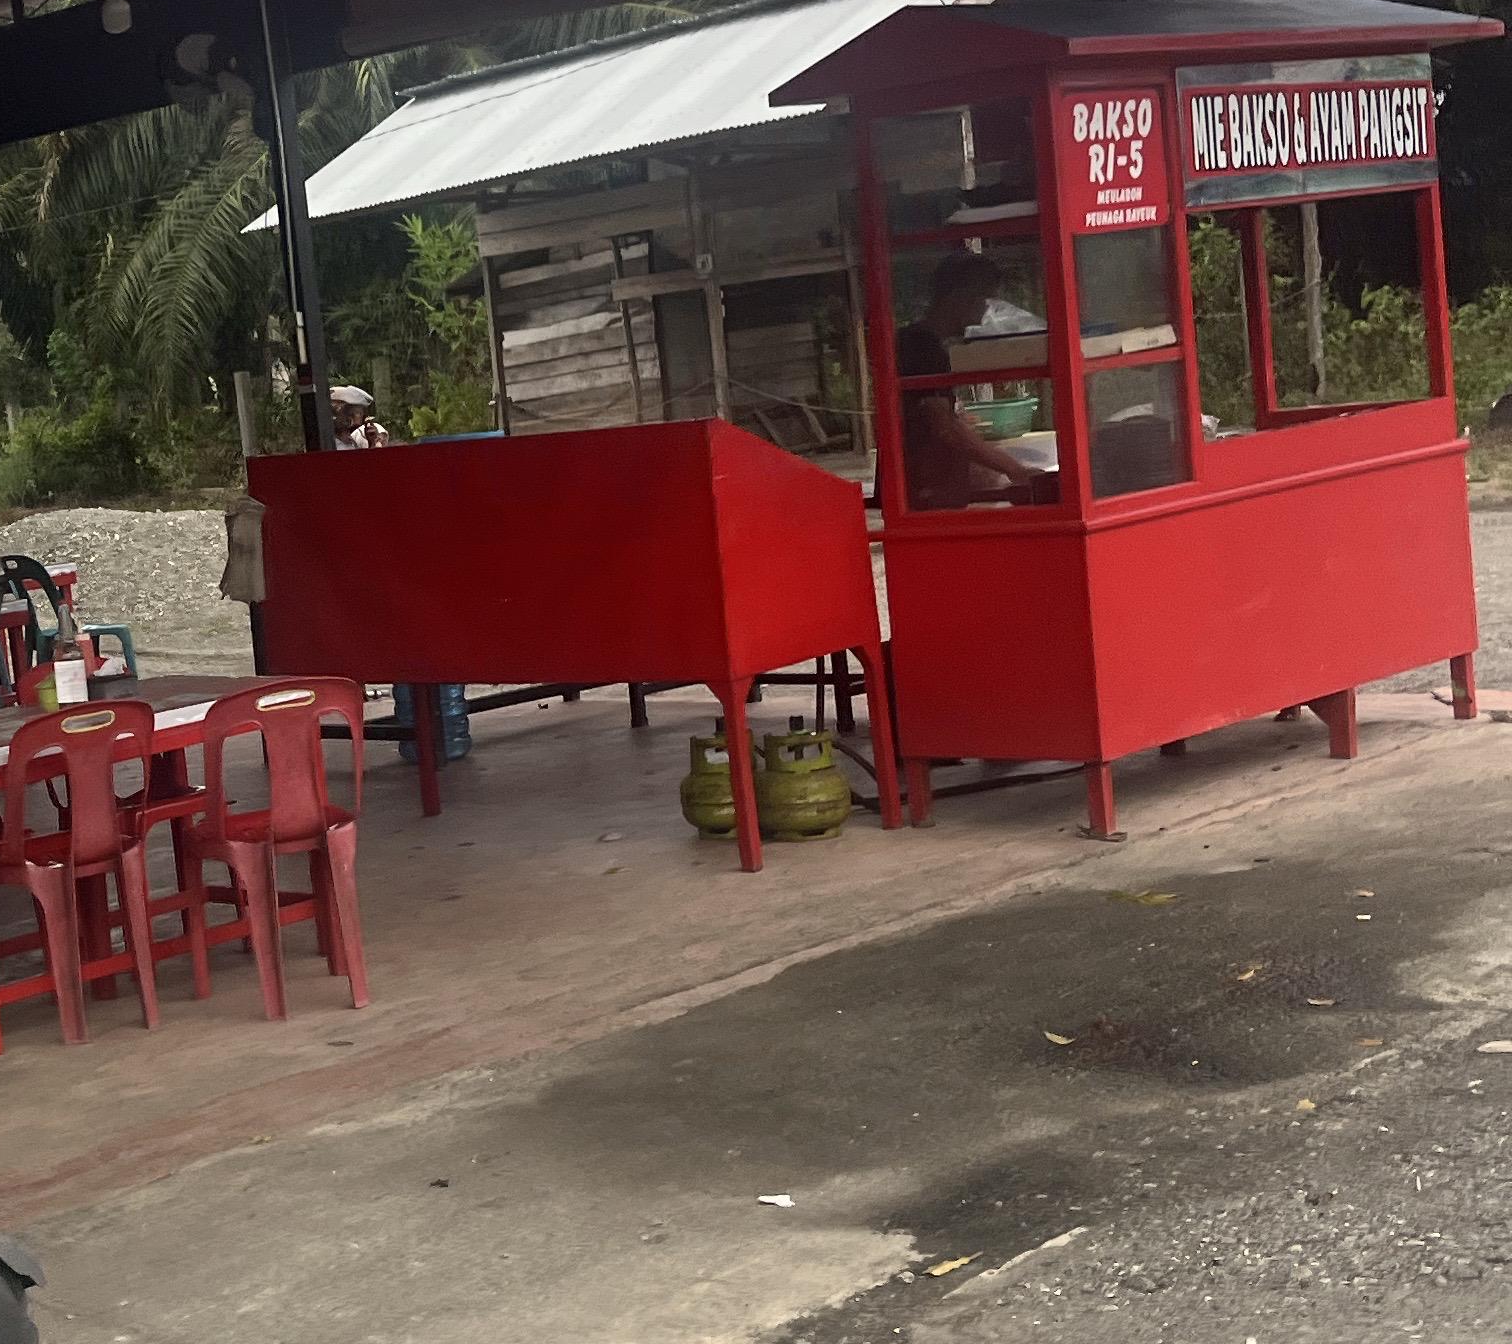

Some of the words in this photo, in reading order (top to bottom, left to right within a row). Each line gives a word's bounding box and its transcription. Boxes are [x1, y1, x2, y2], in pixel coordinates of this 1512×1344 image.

[1073, 98, 1152, 143] BAKSO
[1191, 96, 1227, 171] MIE
[1228, 92, 1290, 169] BAKSO
[1293, 92, 1307, 165] &
[1310, 90, 1357, 163] AYAM
[1358, 86, 1428, 159] PANGSIT
[1088, 139, 1143, 185] RI-5
[1085, 209, 1125, 228] PEUNAGA
